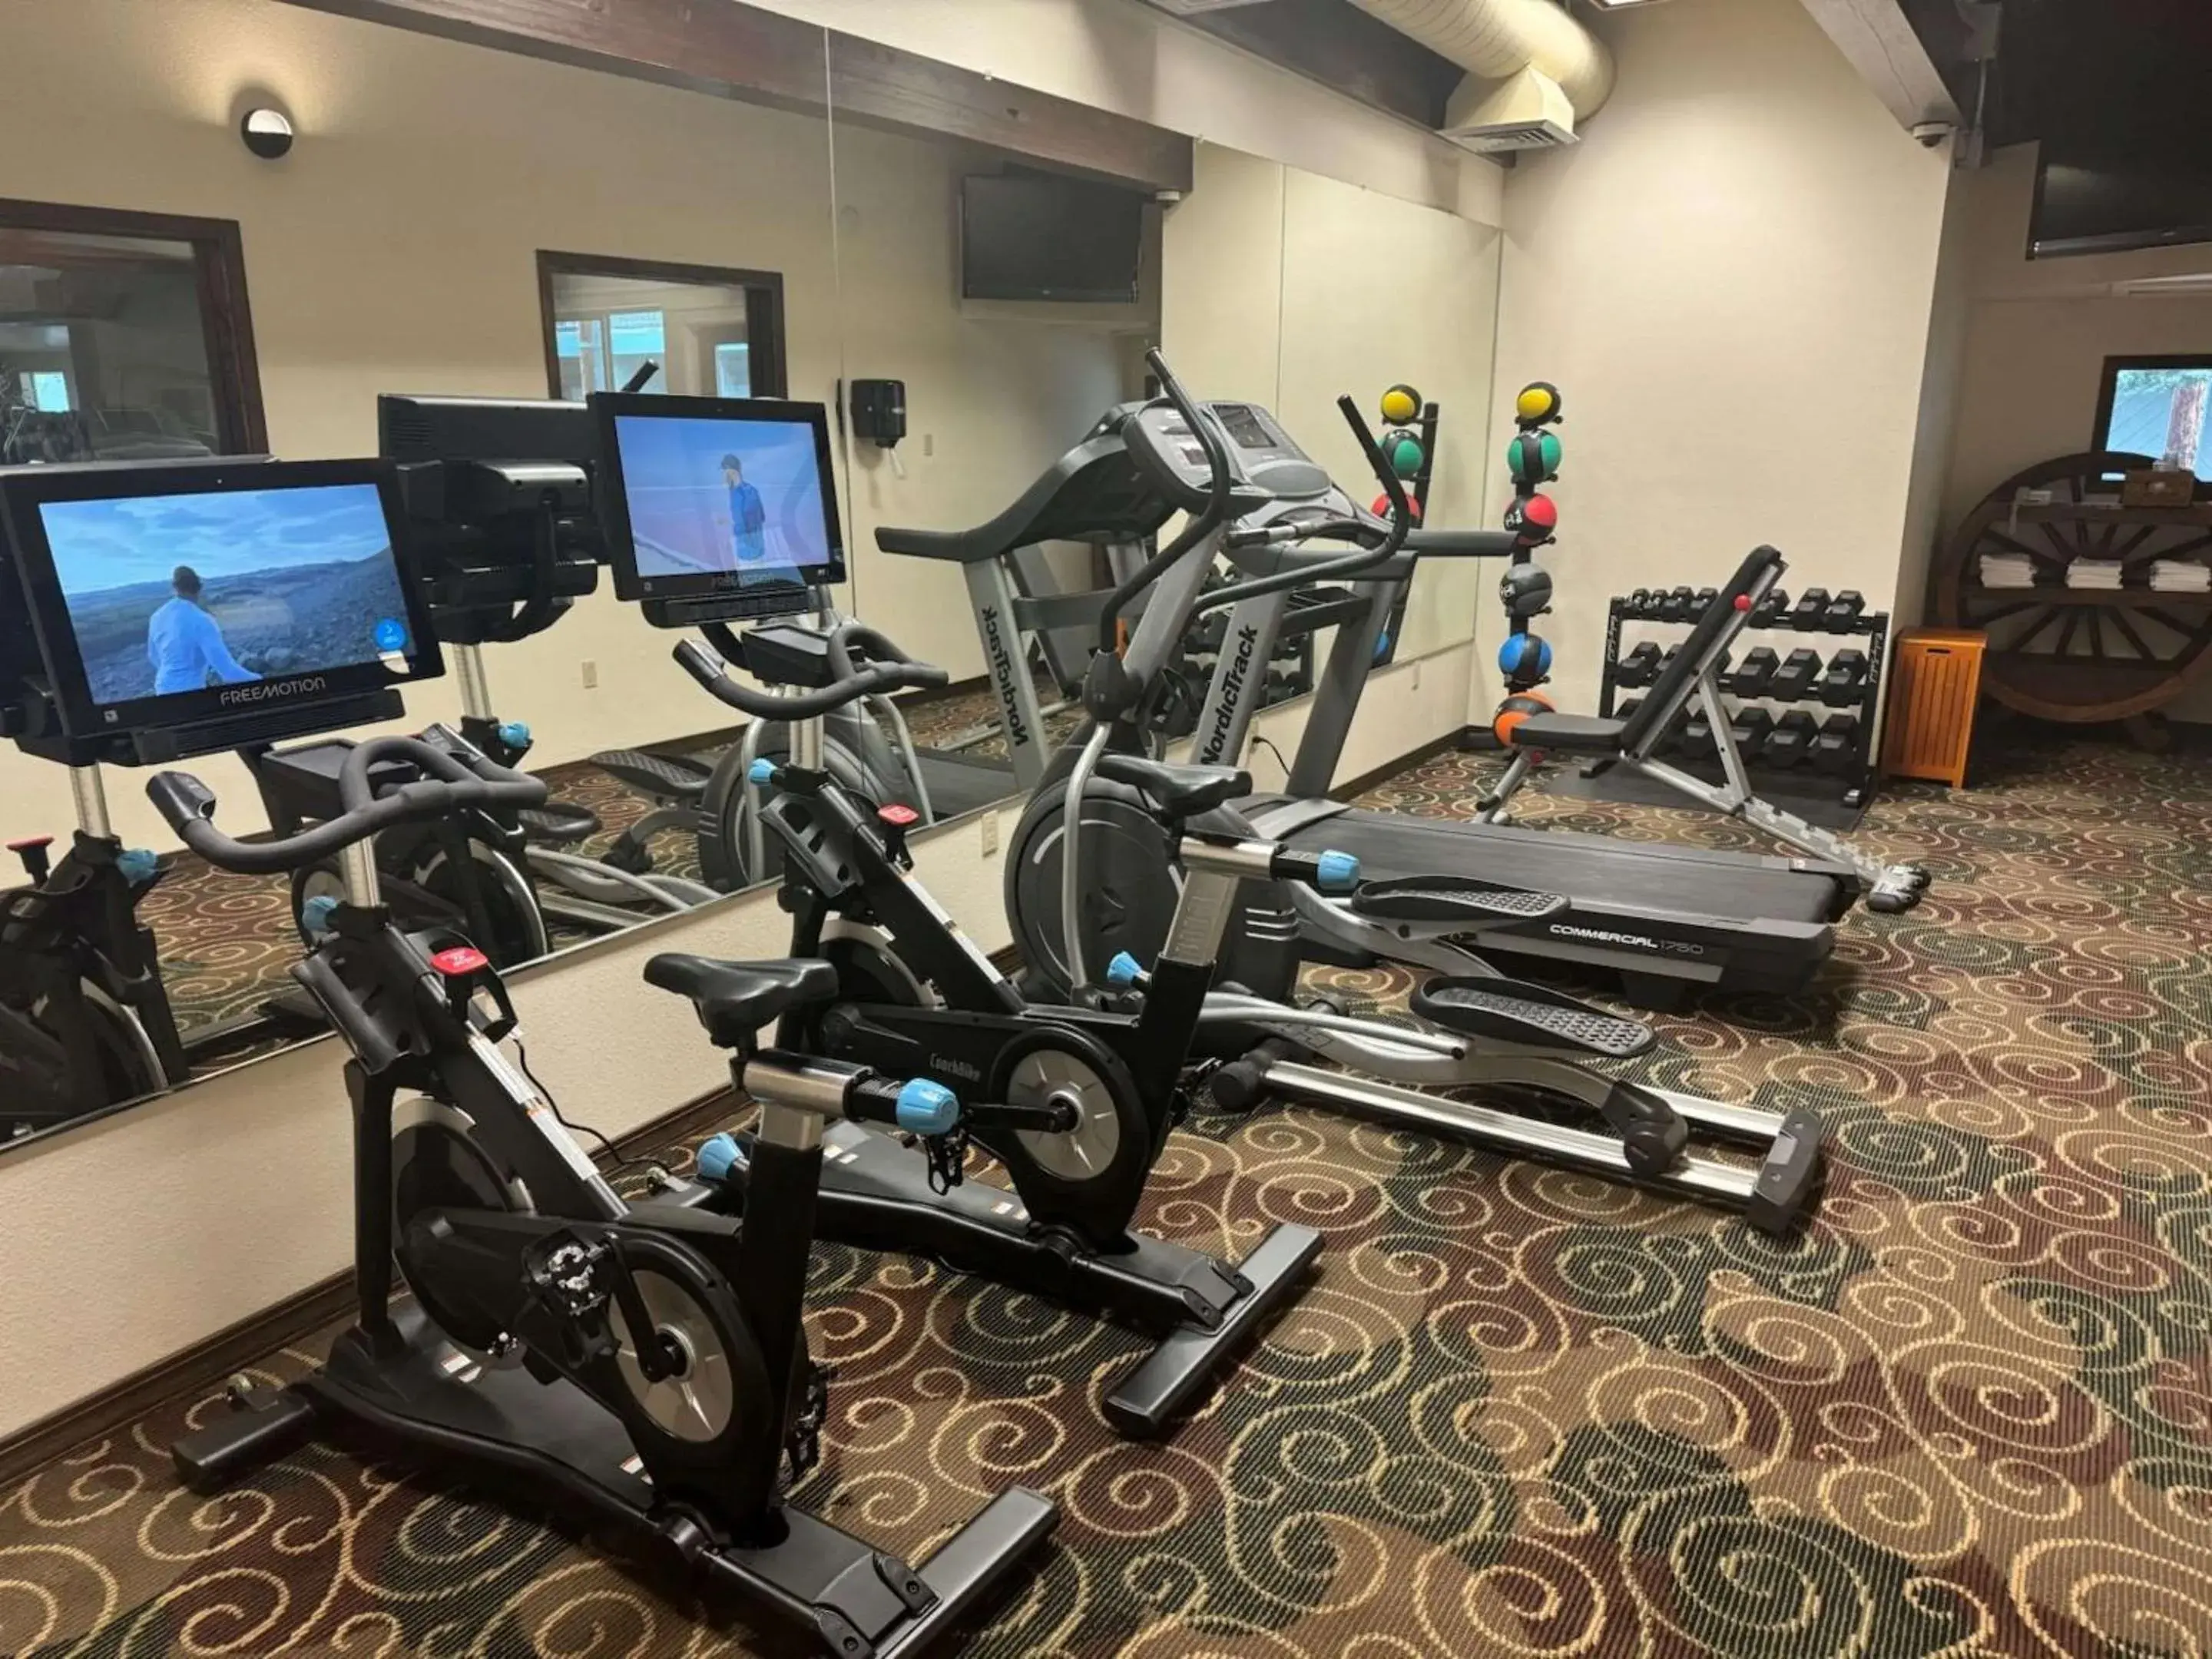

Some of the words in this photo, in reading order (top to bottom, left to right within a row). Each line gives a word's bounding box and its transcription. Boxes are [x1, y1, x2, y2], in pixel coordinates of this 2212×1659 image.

[219, 676, 326, 707] FREEMOTION
[1200, 623, 1259, 766] NordicTrack
[1550, 924, 1658, 949] COMMERCIAL
